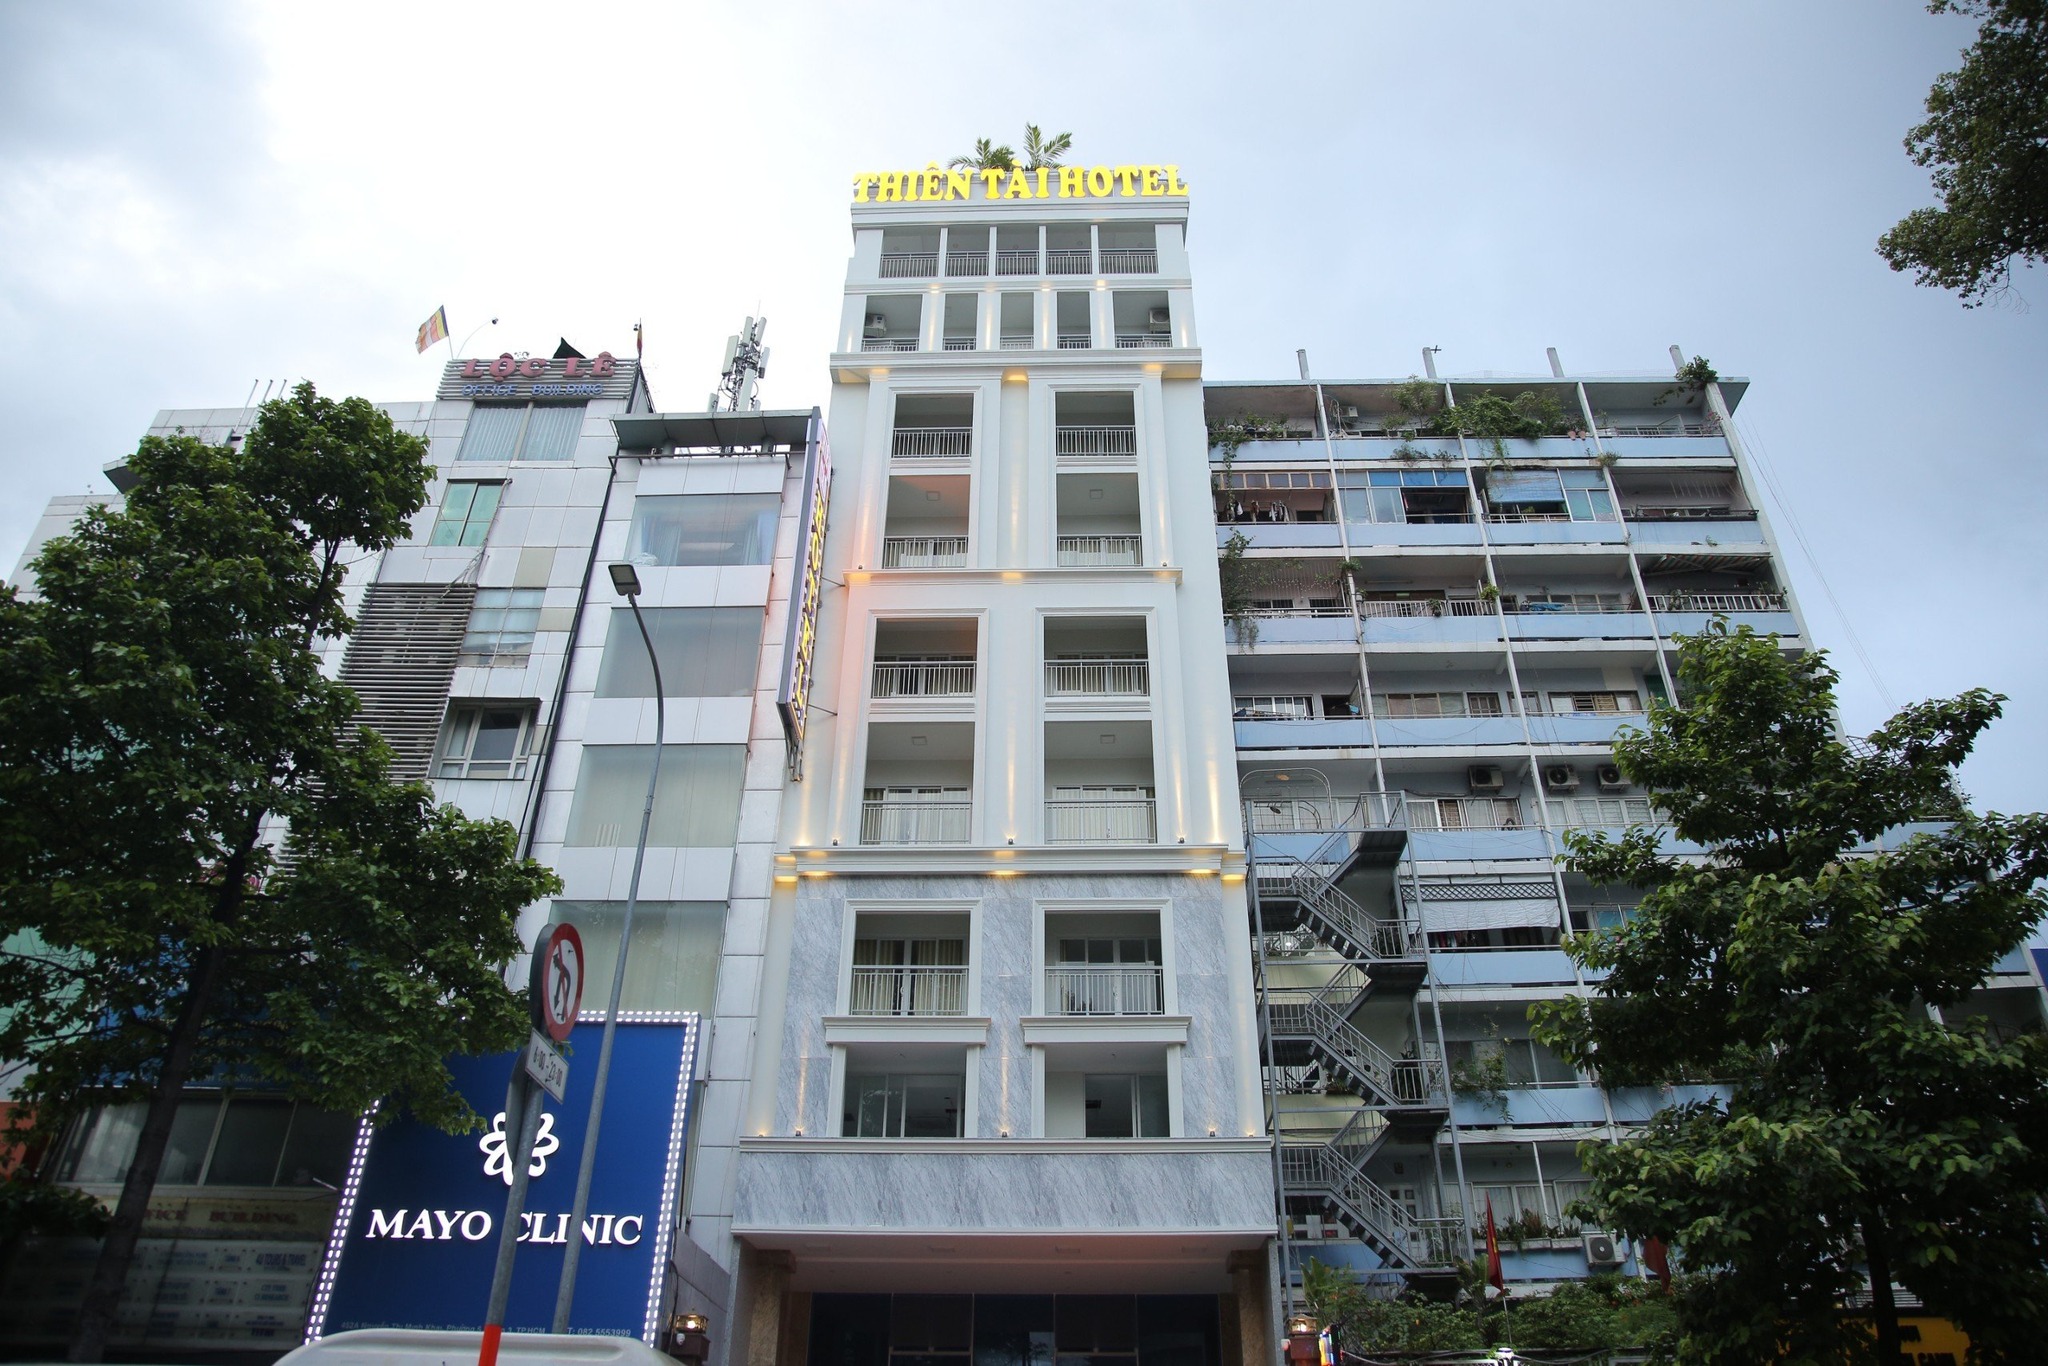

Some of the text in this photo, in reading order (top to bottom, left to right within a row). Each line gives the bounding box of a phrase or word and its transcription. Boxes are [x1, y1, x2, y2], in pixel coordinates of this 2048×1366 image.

[853, 159, 1189, 203] THIÊN TÀI HOTEL
[460, 351, 617, 382] LỘC LÊ
[461, 383, 604, 396] OFFICE BUILDING
[365, 1208, 493, 1241] MAYO
